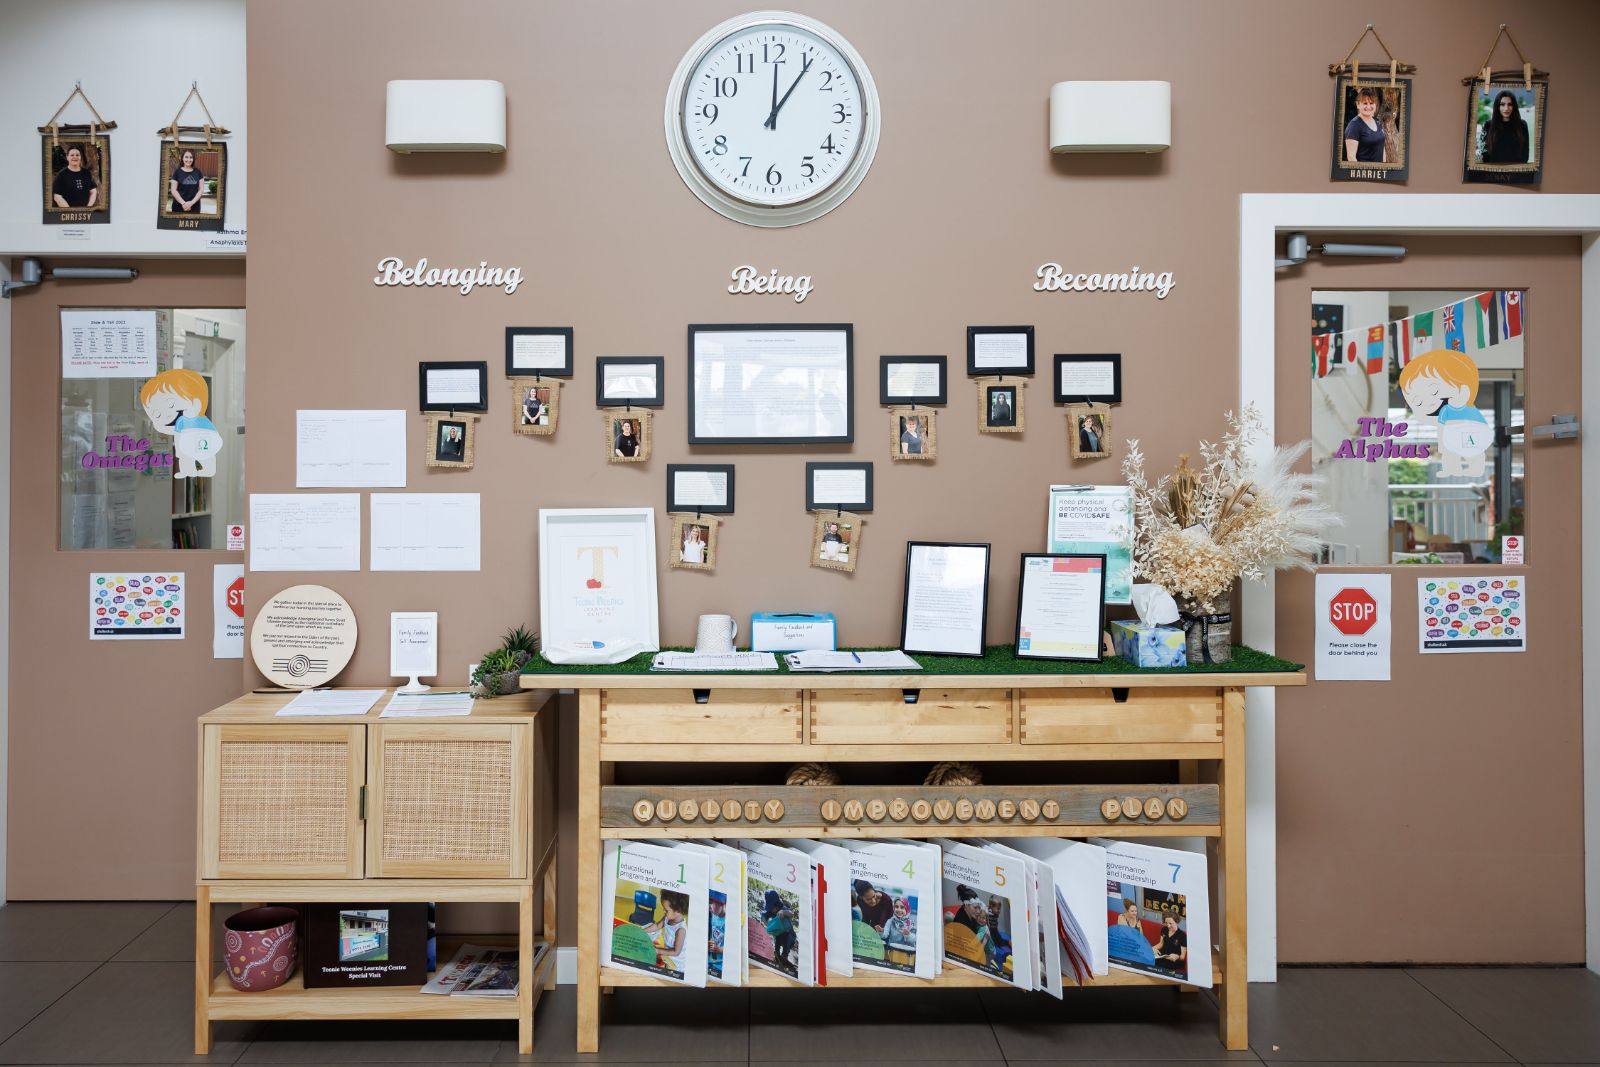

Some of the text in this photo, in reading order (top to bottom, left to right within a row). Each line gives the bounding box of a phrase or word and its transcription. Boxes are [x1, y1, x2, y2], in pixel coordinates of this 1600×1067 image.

[737, 53, 754, 73] 11
[762, 44, 786, 64] 12
[800, 52, 810, 72] 1
[714, 77, 738, 98] 10
[820, 71, 833, 90] 2
[702, 104, 718, 126] 9
[832, 103, 846, 124] 3
[712, 135, 728, 156] 8
[820, 133, 836, 154] 4
[740, 156, 752, 176] 7
[766, 164, 782, 185] 6
[800, 156, 814, 178] 5
[1350, 170, 1388, 180] HARRIET
[61, 213, 92, 222] CHRISSY
[178, 220, 200, 228] MARY
[374, 256, 524, 296] Belonging
[728, 265, 813, 303] Being
[1033, 262, 1176, 300] Becoming
[1358, 417, 1408, 438] The
[106, 434, 150, 452] The
[1334, 439, 1430, 462] Alphas
[82, 451, 174, 472] Omegas
[1332, 602, 1374, 622] STOP
[633, 798, 1187, 820] QUALITY IMPROVEMENT PLAN
[620, 864, 654, 876] educational
[676, 864, 687, 884] 1
[714, 863, 725, 884] 2
[786, 863, 796, 883] 3
[902, 860, 915, 878] 4
[944, 861, 980, 877] relationships
[944, 868, 980, 884] with children
[994, 866, 1006, 887] 5
[1106, 862, 1146, 875] governance
[1168, 862, 1181, 883] 7
[620, 870, 644, 881] program
[657, 879, 680, 889] practice
[1120, 872, 1157, 886] leadership
